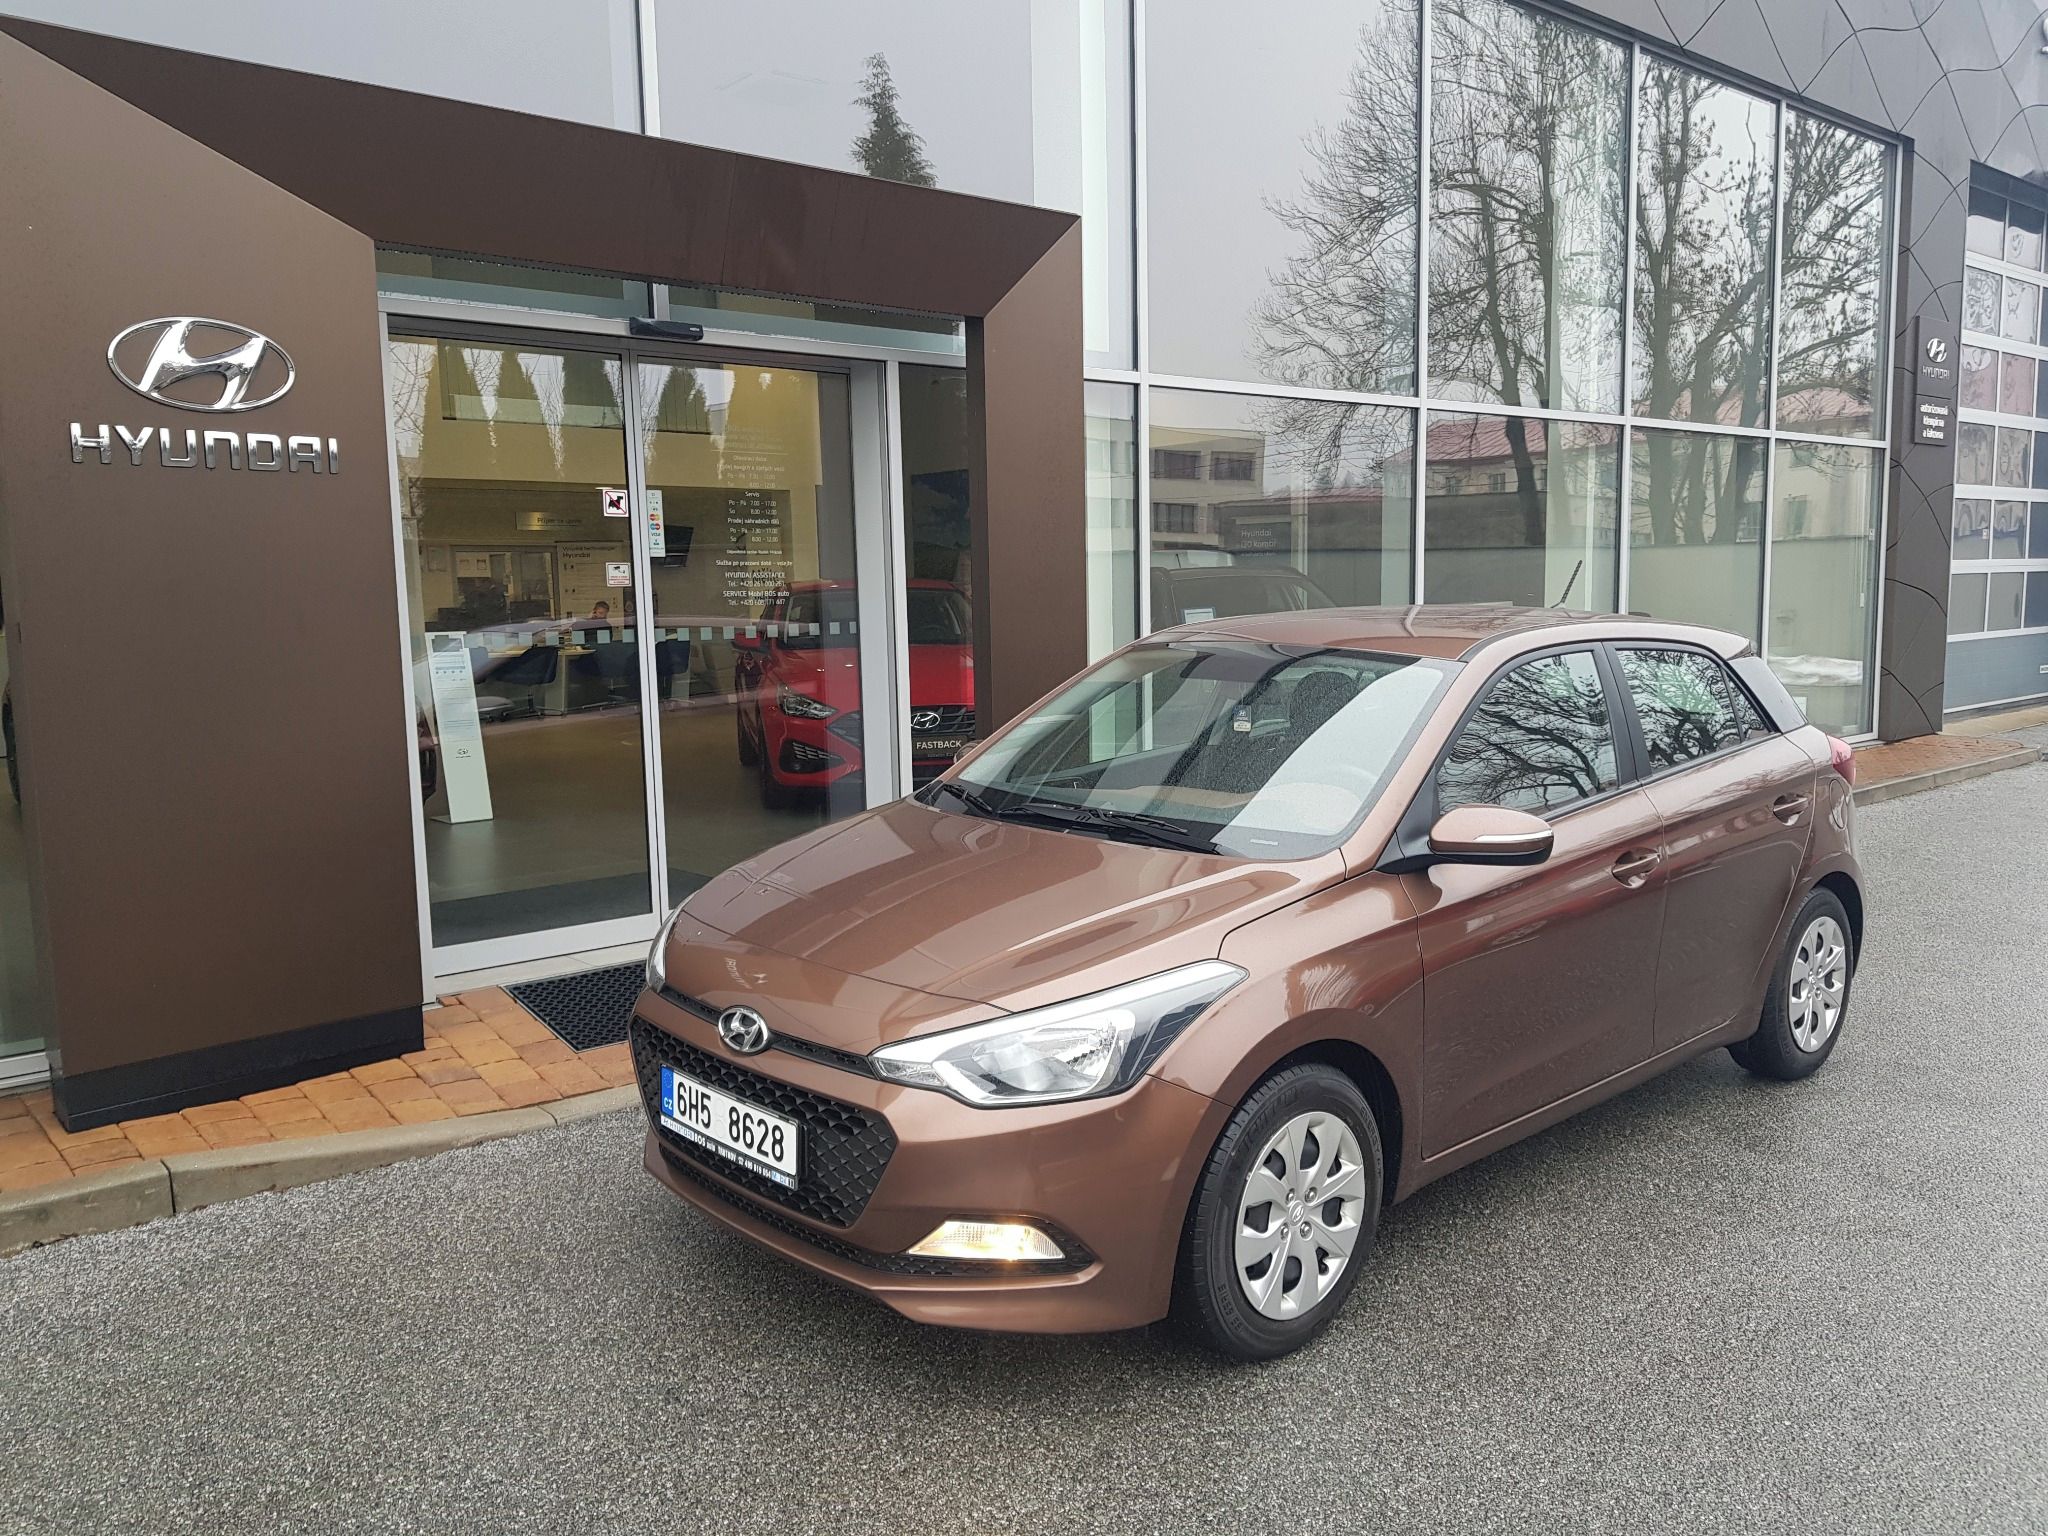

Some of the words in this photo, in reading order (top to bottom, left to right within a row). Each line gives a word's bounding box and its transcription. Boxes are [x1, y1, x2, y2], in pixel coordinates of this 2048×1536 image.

[1922, 365, 1950, 380] HYUNDAI
[69, 421, 340, 475] HYUNDAI
[728, 517, 744, 525] Prodej
[1241, 529, 1272, 538] Hyundai
[725, 571, 752, 579] HYUNDAI
[916, 740, 962, 749] FASTBACK
[663, 1096, 673, 1111] CZ
[676, 1081, 712, 1130] 6H5
[728, 1105, 785, 1163] 8628
